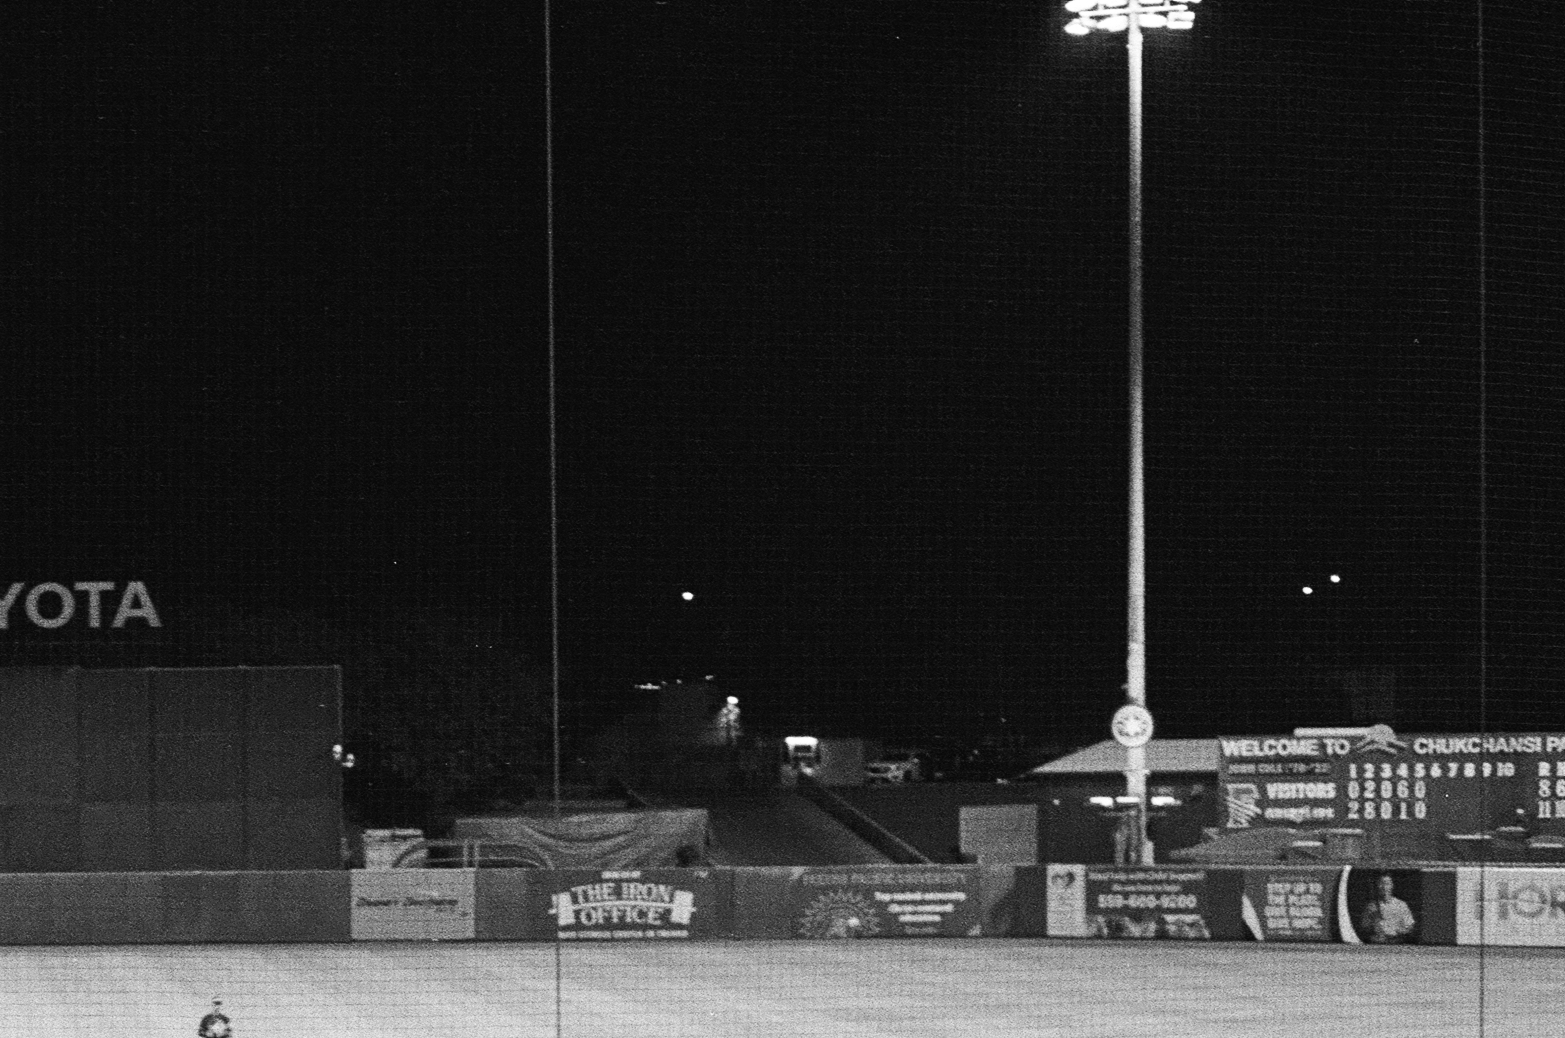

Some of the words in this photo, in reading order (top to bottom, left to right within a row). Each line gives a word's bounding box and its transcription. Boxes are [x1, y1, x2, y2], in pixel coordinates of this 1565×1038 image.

[1221, 737, 1320, 757] WELCOME
[1323, 738, 1350, 756] TO
[1414, 736, 1543, 754] CHUKCHANSI
[571, 881, 616, 905] THE
[621, 881, 674, 903] IRON
[579, 905, 664, 926] OFFICE
